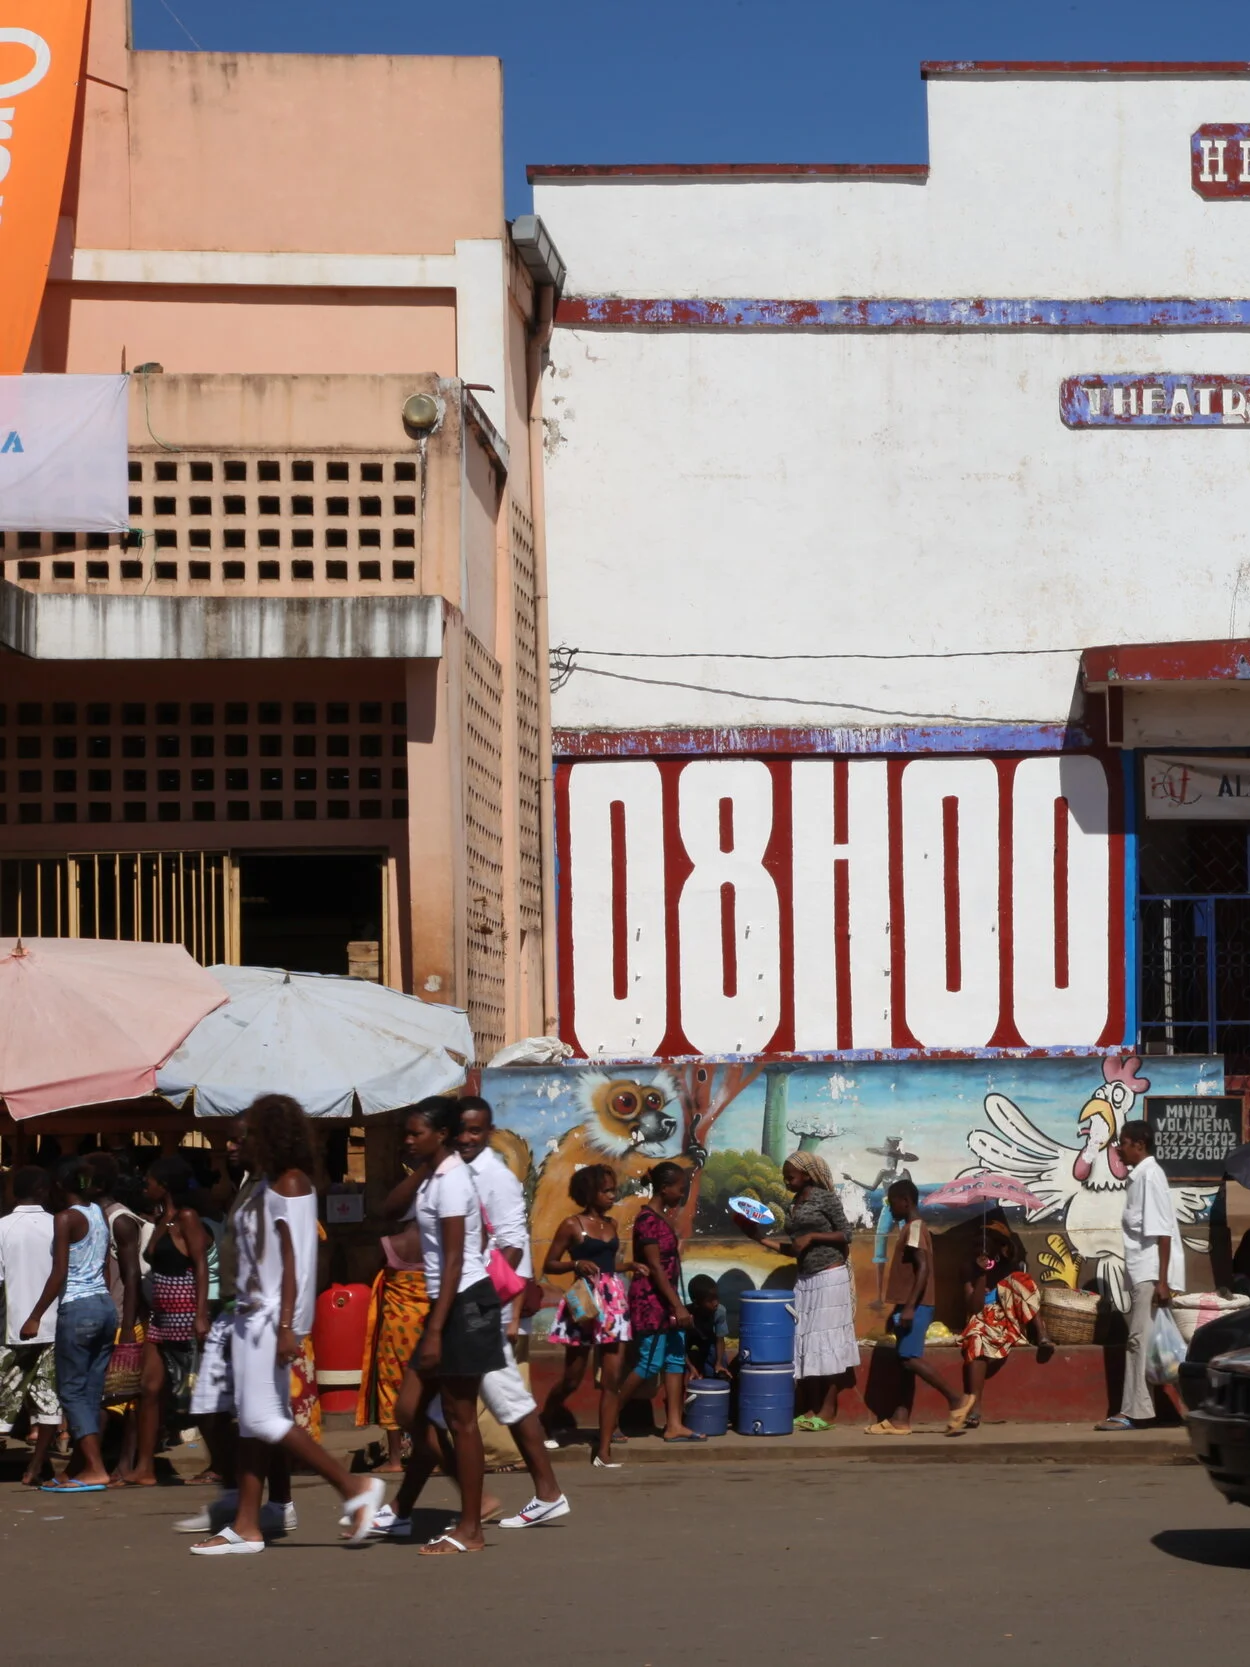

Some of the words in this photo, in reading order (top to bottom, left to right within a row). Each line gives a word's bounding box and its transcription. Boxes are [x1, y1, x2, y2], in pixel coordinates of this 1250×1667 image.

[1157, 1118, 1232, 1132] VOLAMENA
[1154, 1131, 1237, 1146] 0322956702
[1156, 1146, 1237, 1160] 032736007
